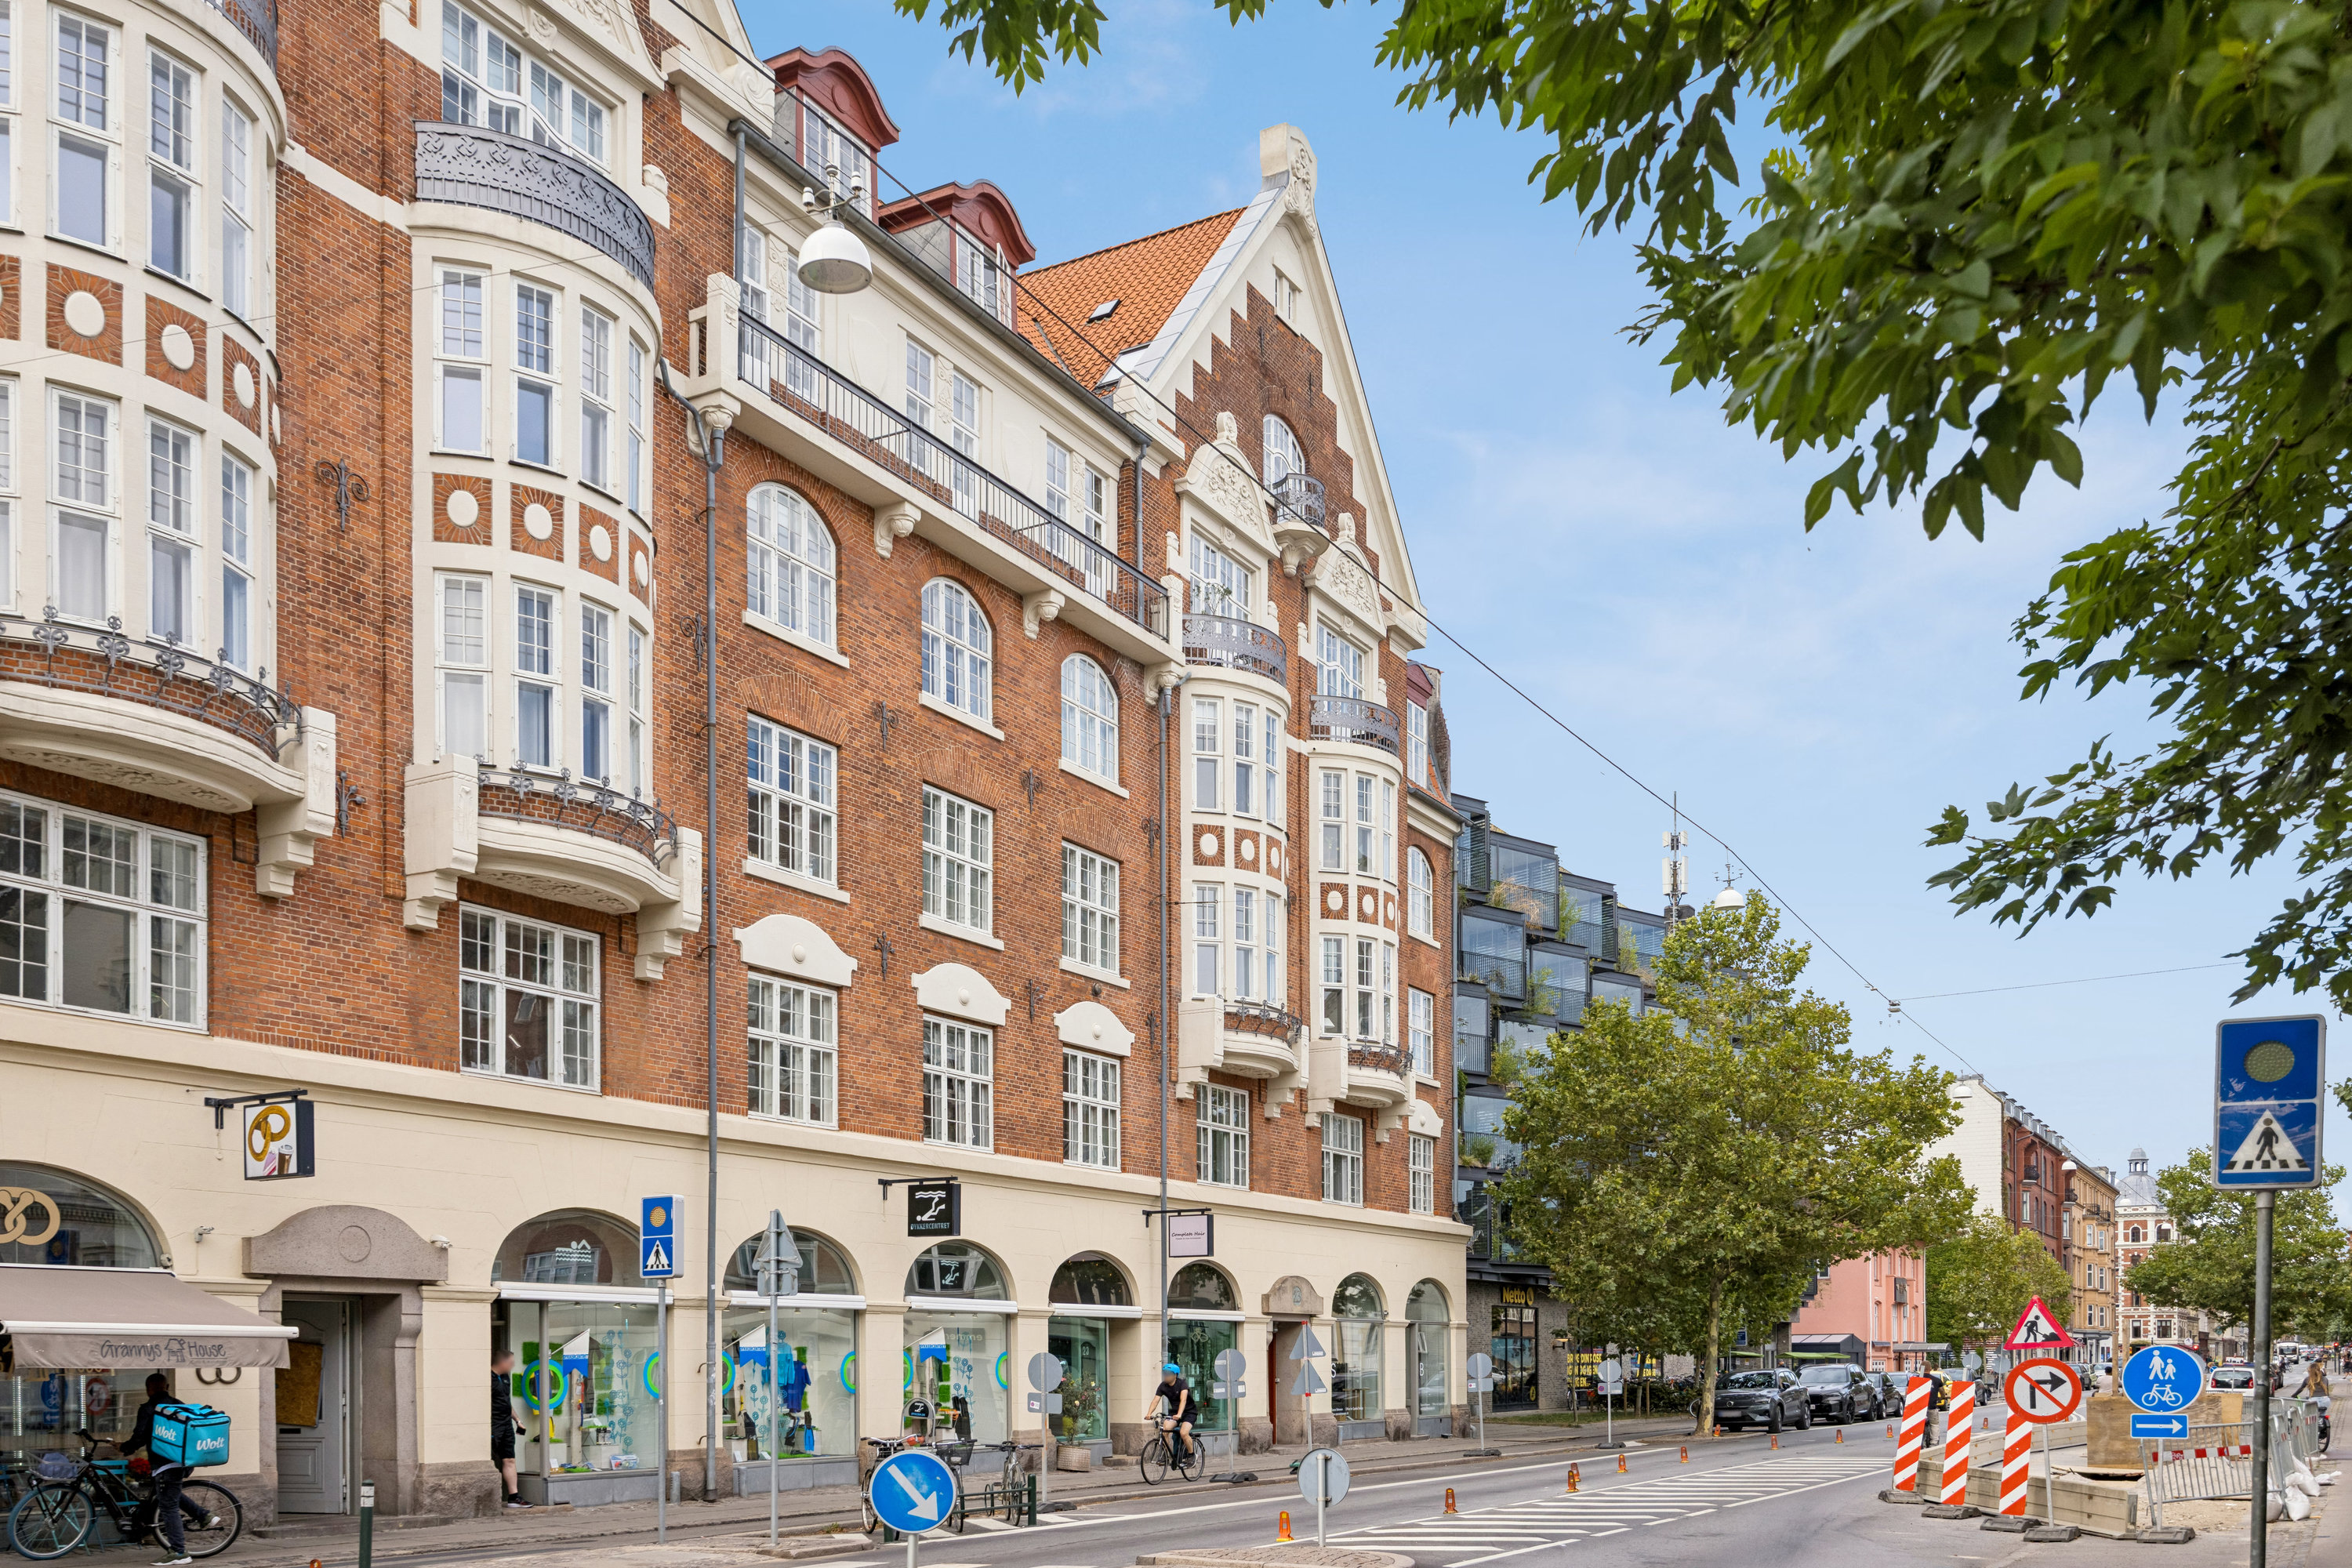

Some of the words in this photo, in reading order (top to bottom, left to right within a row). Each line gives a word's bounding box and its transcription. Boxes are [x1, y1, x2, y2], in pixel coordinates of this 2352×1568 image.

[1503, 1287, 1526, 1304] Netto
[101, 1340, 162, 1362] Grannys
[188, 1341, 226, 1357] House
[1567, 1353, 1580, 1363] BRG
[1581, 1353, 1589, 1363] DIN
[1420, 1363, 1425, 1376] B
[1567, 1365, 1579, 1375] IGN
[155, 1424, 176, 1441] Wolt
[196, 1437, 225, 1450] Wolt
